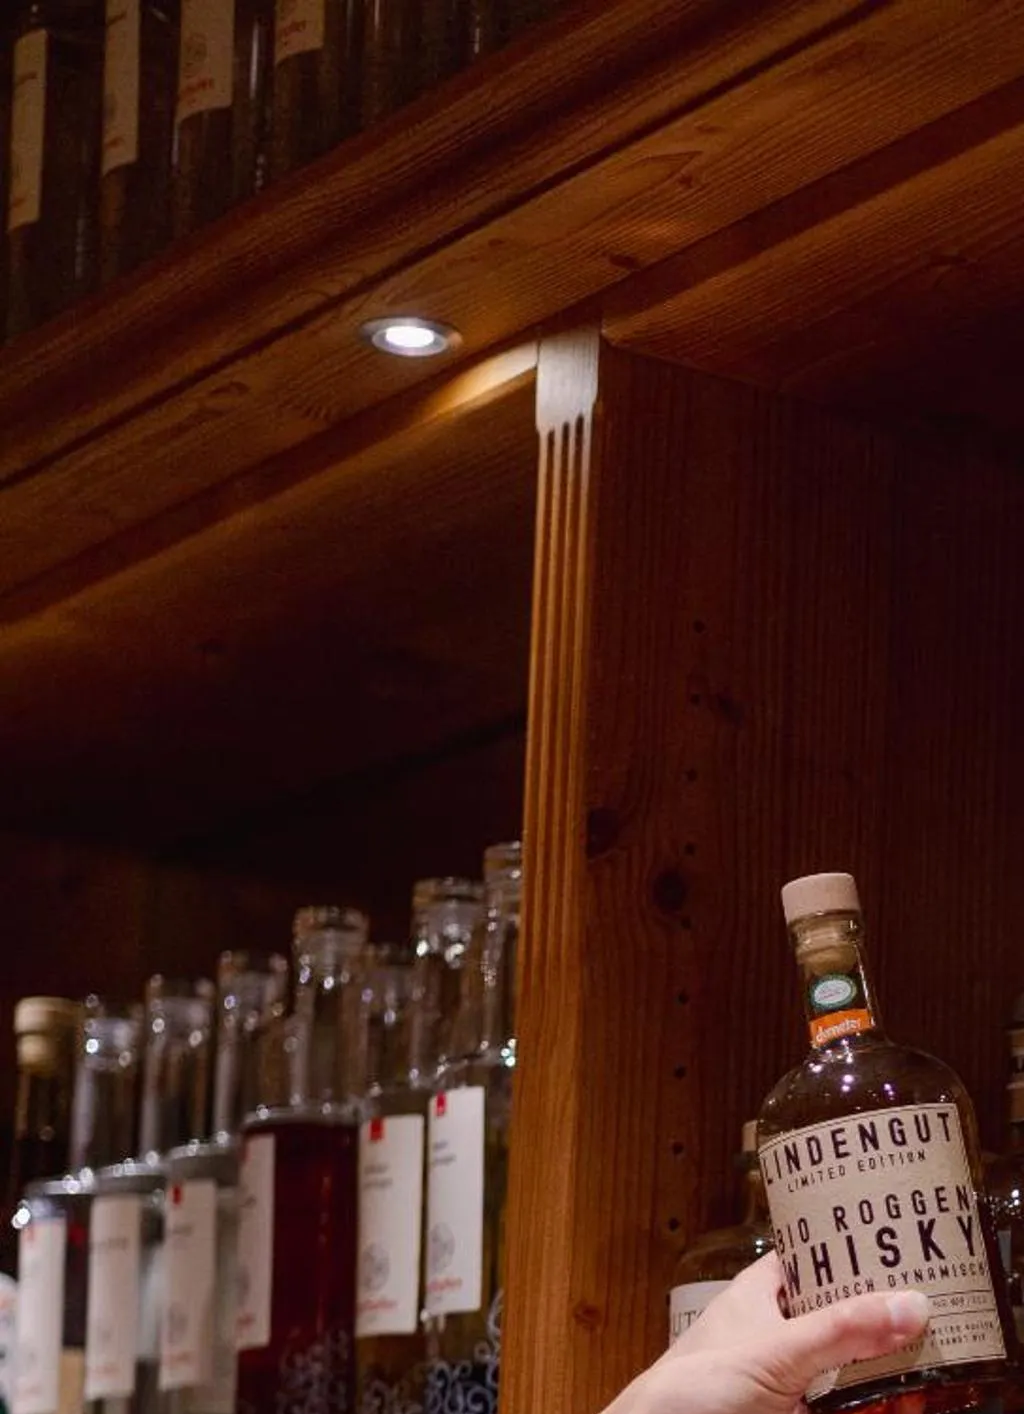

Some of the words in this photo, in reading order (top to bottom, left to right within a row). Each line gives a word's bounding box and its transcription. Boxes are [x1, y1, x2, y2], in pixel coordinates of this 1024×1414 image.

[761, 1112, 952, 1185] LINDENGUT
[787, 1166, 846, 1193] LIMITED
[857, 1149, 927, 1173] EDITION
[775, 1217, 811, 1255] BIO
[832, 1184, 973, 1233] ROGGEN
[780, 1216, 976, 1298] WHISKY
